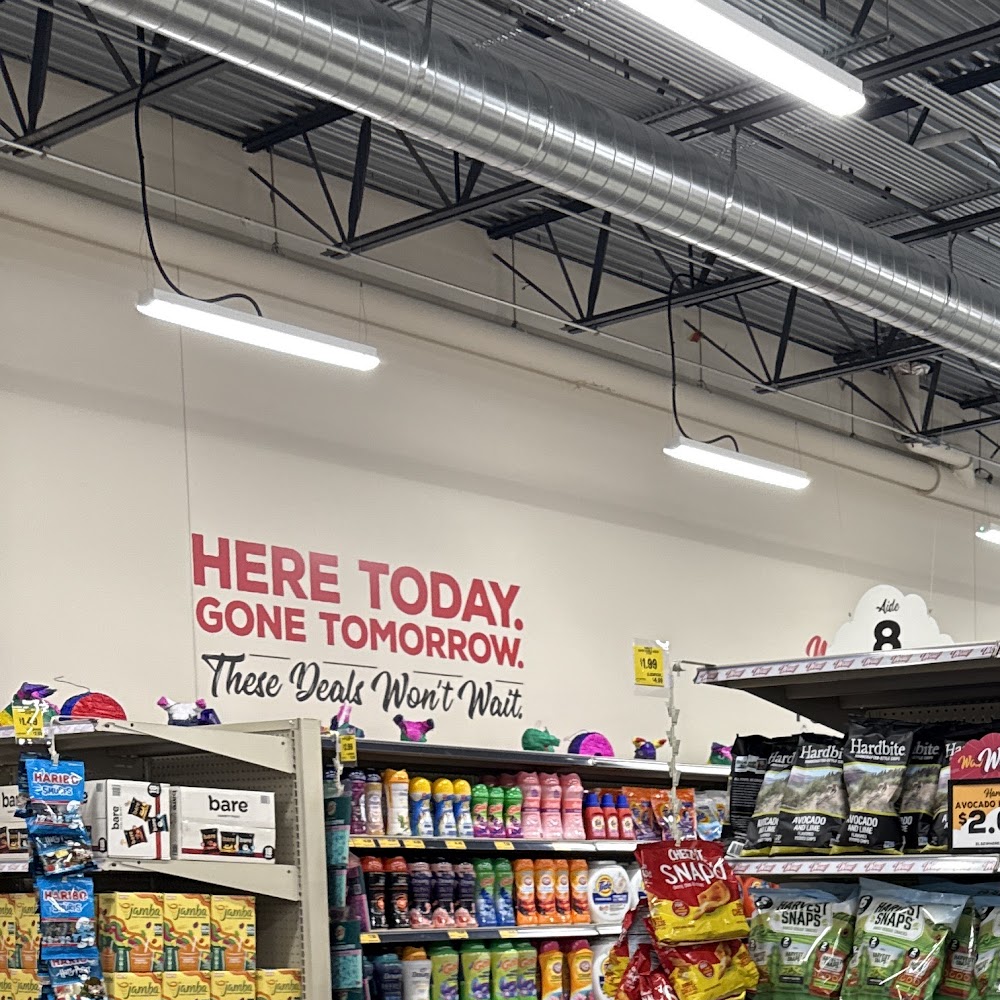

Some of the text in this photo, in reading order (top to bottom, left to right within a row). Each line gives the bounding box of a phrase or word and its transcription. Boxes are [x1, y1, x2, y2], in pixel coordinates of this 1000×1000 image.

[192, 533, 524, 630] HERE TODAY.
[876, 598, 900, 614] Aisle
[196, 597, 524, 669] GONE TOMORROW.
[873, 619, 902, 652] 8
[202, 654, 523, 719] These Deals Won't Wait.
[800, 744, 843, 759] Hardbi
[850, 738, 906, 756] Hardbite
[208, 795, 248, 812] bare
[955, 801, 995, 809] AVOCADO
[111, 806, 119, 830] bare
[792, 815, 826, 825] AVOCADO
[44, 890, 87, 900] HARIBO
[127, 903, 161, 920] jamba
[174, 903, 208, 920] jamba
[221, 903, 253, 921] jamba
[781, 909, 822, 927] SNAPS
[874, 911, 913, 930] SNAPS
[124, 983, 159, 999] jamba
[174, 981, 207, 998] jamba
[221, 982, 253, 998] jamba
[271, 979, 300, 995] jamba
